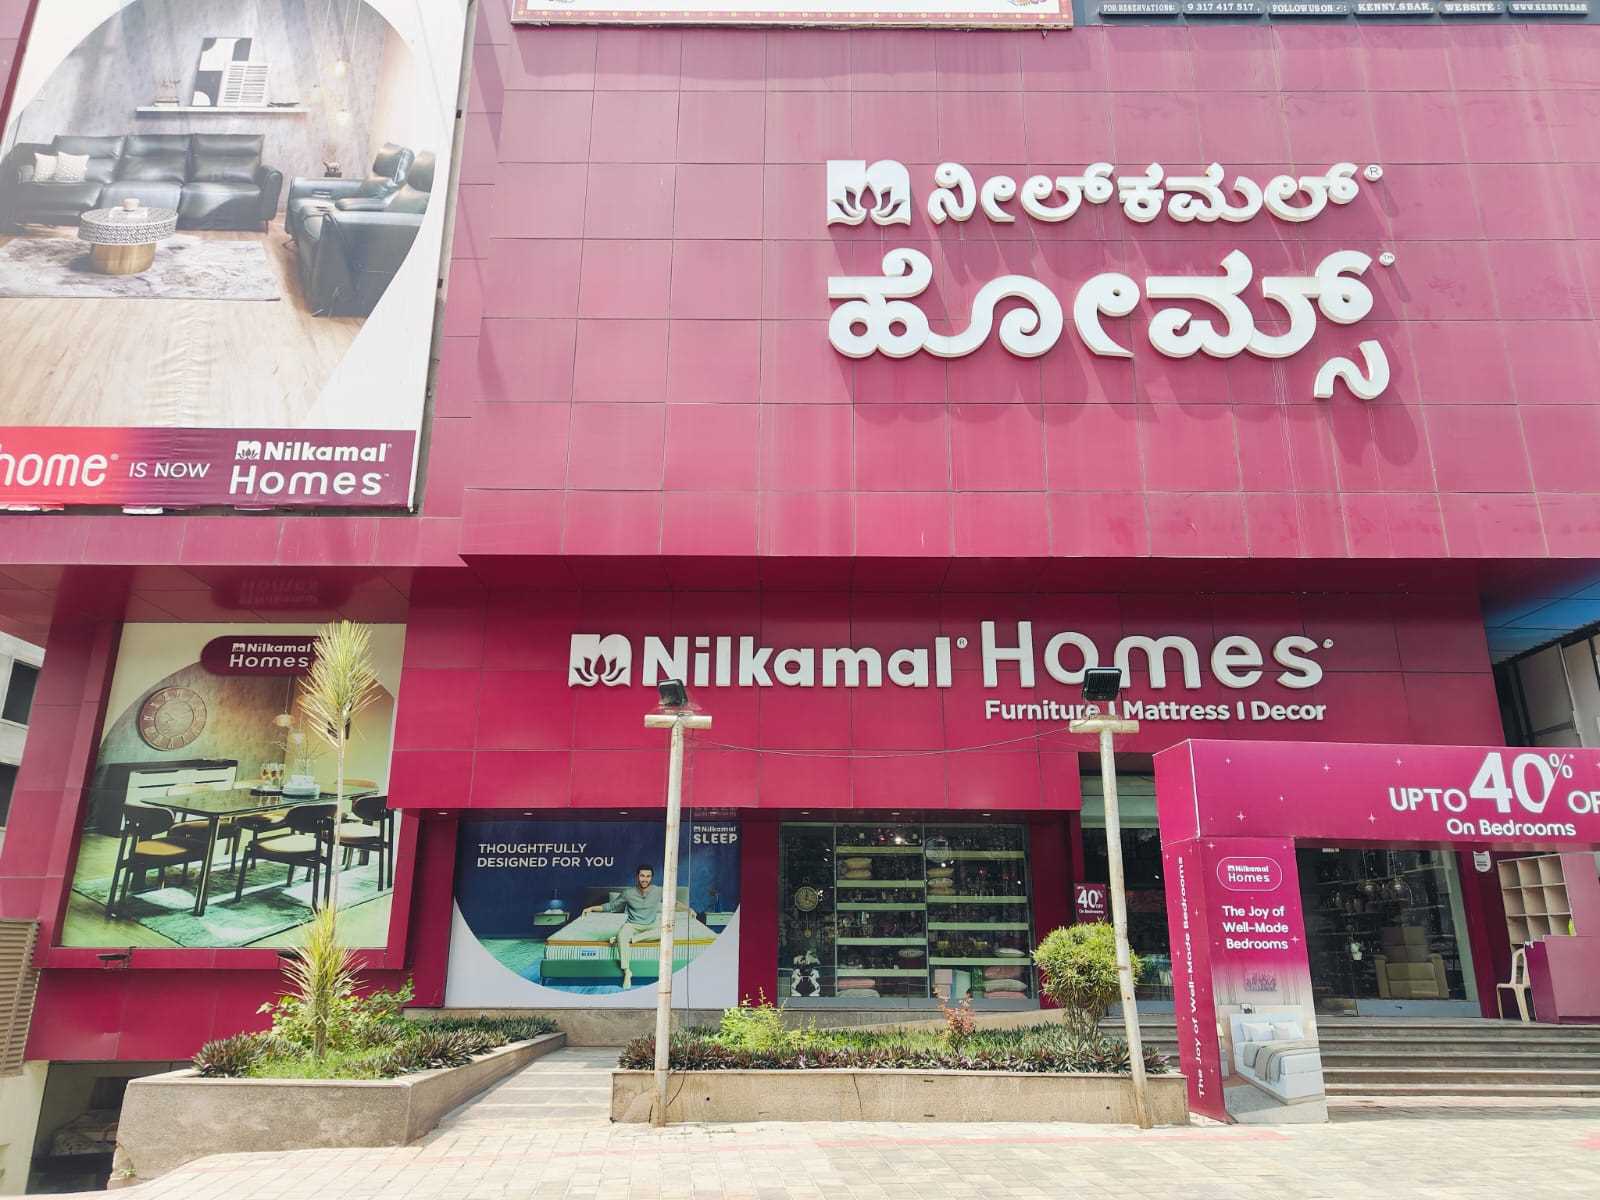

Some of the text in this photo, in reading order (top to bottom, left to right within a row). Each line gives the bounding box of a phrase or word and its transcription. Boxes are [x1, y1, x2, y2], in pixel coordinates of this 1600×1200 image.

[129, 462, 147, 478] IS
[154, 462, 210, 478] NOW
[229, 465, 384, 495] Homes
[248, 643, 311, 653] Nilkamal
[229, 654, 309, 668] Homes
[985, 700, 1327, 721] Furniture Mattress Decor
[1388, 787, 1468, 813] UPTO
[1446, 818, 1577, 837] On Bedrooms
[693, 833, 738, 844] SLEEP
[478, 843, 587, 854] THOUGHTFULLY
[476, 857, 614, 868] DESIGNED FOR YOU
[1228, 873, 1270, 883] Homes
[1178, 856, 1190, 930] Bedrooms
[1223, 905, 1285, 920] The Joy of
[1223, 922, 1289, 933] Well-Made
[1226, 938, 1288, 950] Bedrooms
[1192, 1016, 1200, 1035] of
